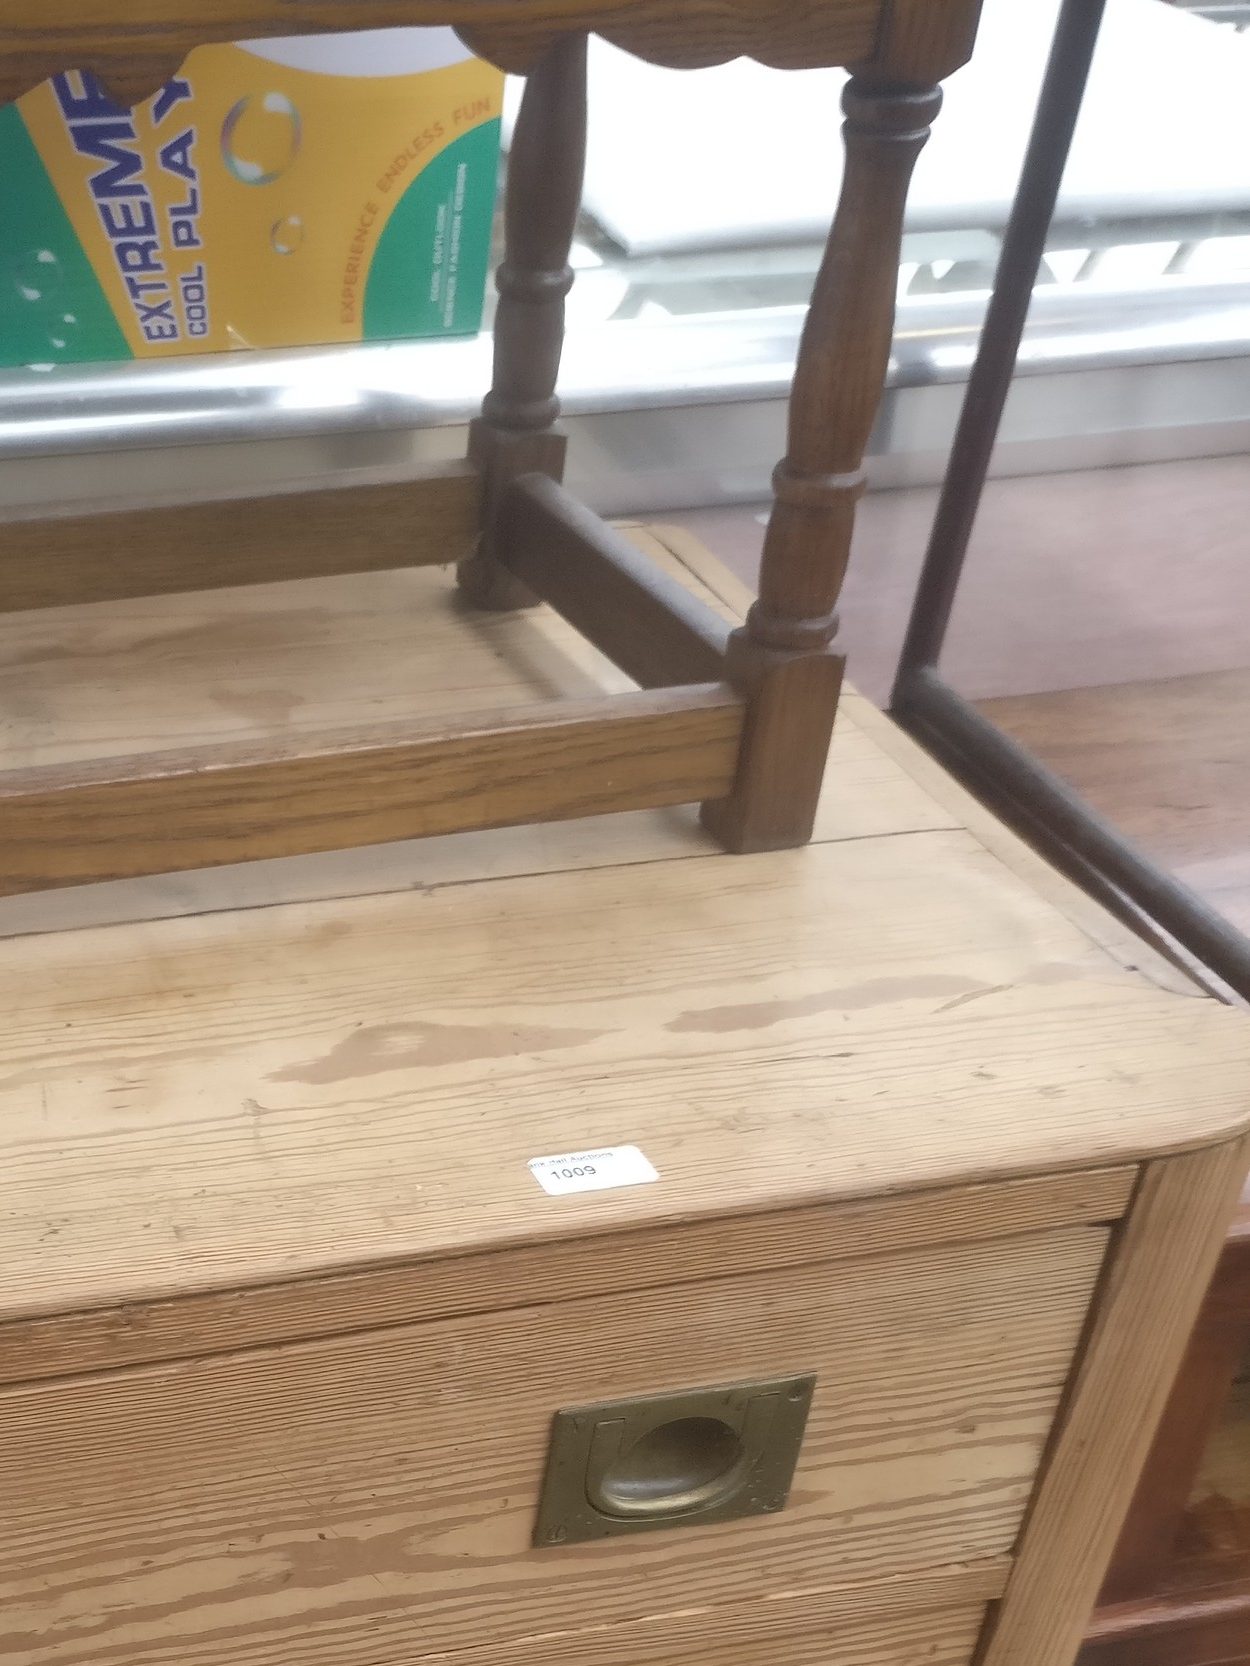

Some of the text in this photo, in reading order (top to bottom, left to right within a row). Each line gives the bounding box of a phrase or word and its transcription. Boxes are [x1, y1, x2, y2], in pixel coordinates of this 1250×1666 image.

[153, 80, 207, 337] COOL PLAY
[341, 98, 490, 324] EXPERIENCE ENDLESS FUN
[551, 1165, 597, 1180] 1009
[570, 1151, 614, 1163] Auctions
